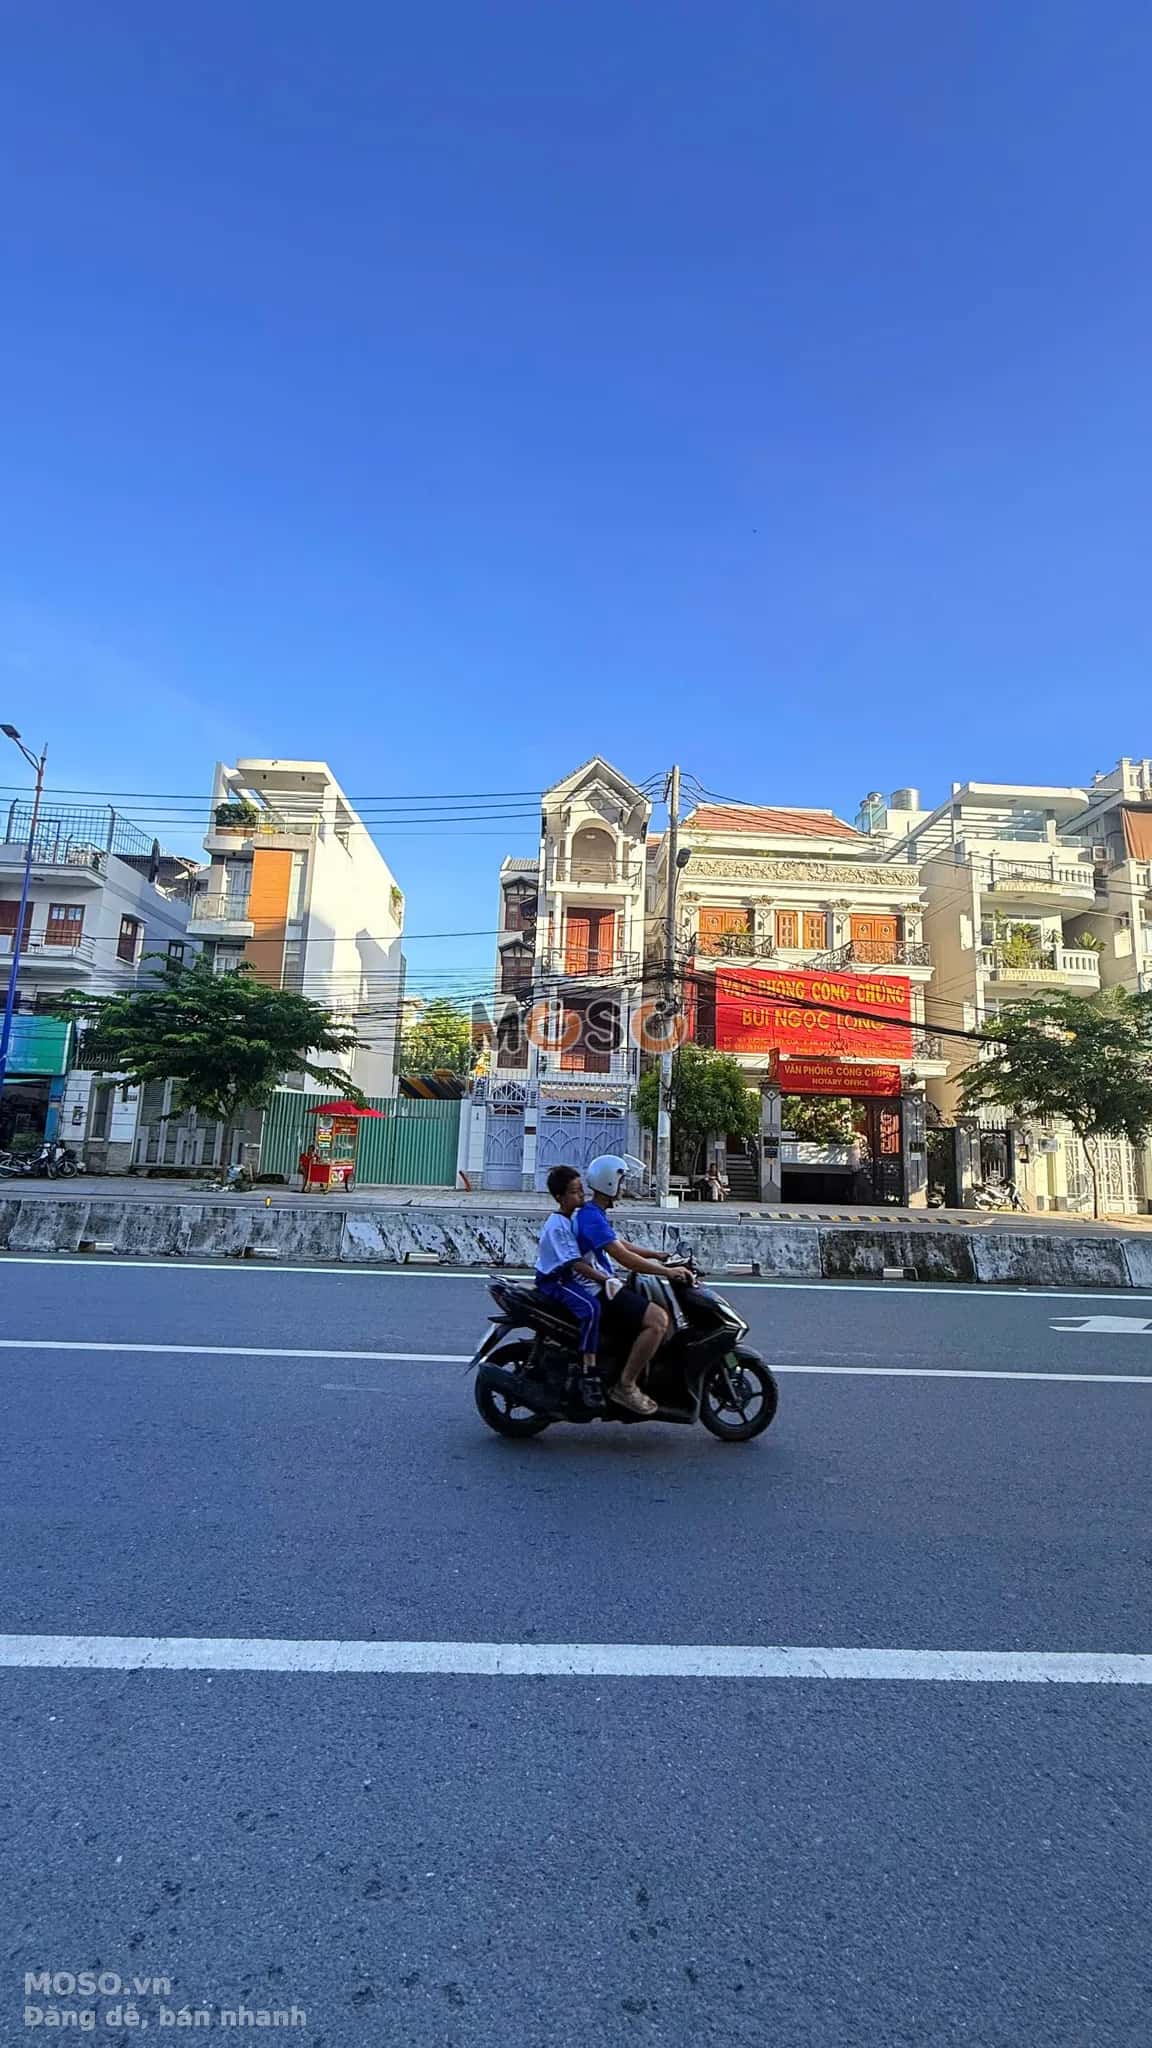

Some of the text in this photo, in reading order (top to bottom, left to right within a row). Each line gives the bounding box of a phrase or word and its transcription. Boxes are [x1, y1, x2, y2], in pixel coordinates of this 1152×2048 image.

[812, 977, 850, 1001] CÔNG
[812, 1078, 869, 1087] NOTARY OFFICE
